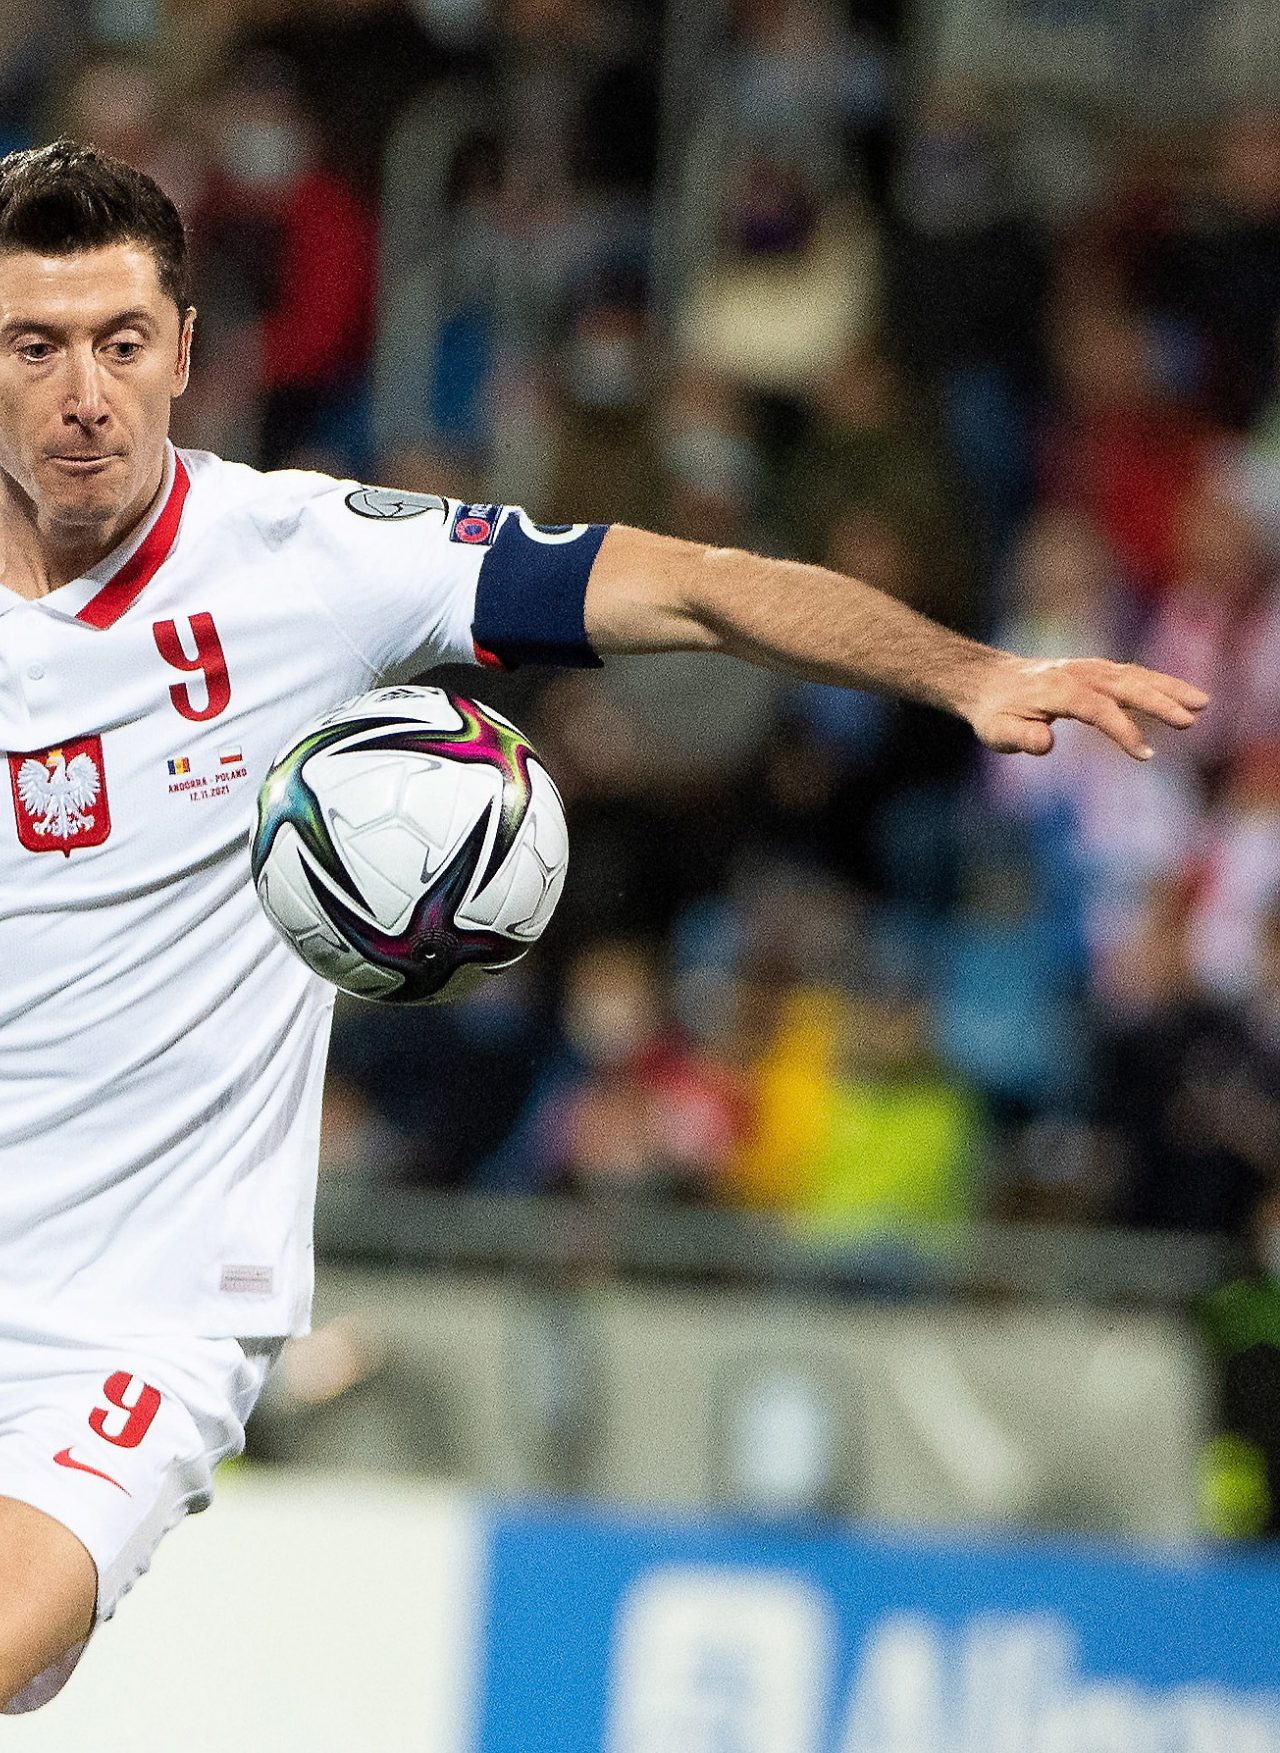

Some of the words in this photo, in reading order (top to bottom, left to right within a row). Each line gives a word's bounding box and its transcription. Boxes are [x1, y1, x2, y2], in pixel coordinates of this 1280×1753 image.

[152, 611, 231, 722] 9
[168, 777, 208, 793] ANDORRA
[214, 767, 248, 783] POLAND
[189, 785, 230, 802] 12.11.2021
[88, 1370, 162, 1449] 9
